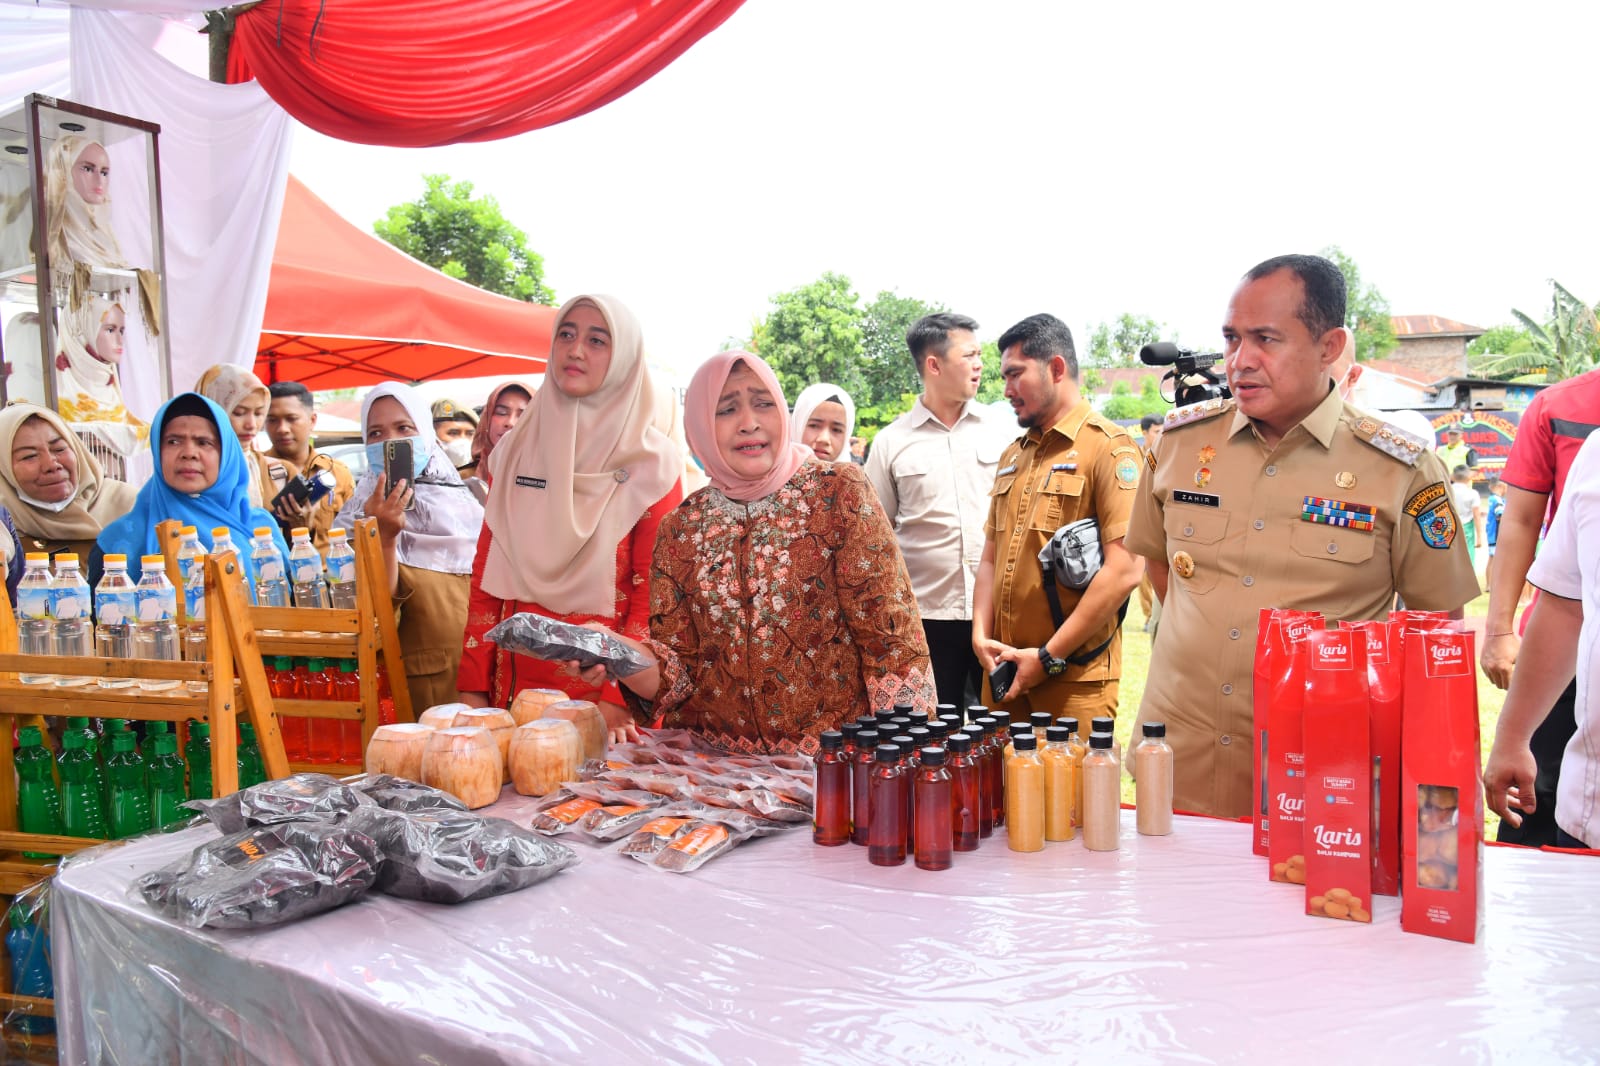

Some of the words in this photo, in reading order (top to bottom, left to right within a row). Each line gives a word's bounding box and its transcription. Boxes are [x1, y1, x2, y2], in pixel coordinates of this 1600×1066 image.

[1182, 494, 1210, 504] ZAHIR
[1318, 643, 1347, 658] Laris
[1367, 639, 1383, 650] ris
[1431, 645, 1462, 661] Laris
[1277, 792, 1305, 815] Lar
[1313, 825, 1362, 849] Laris
